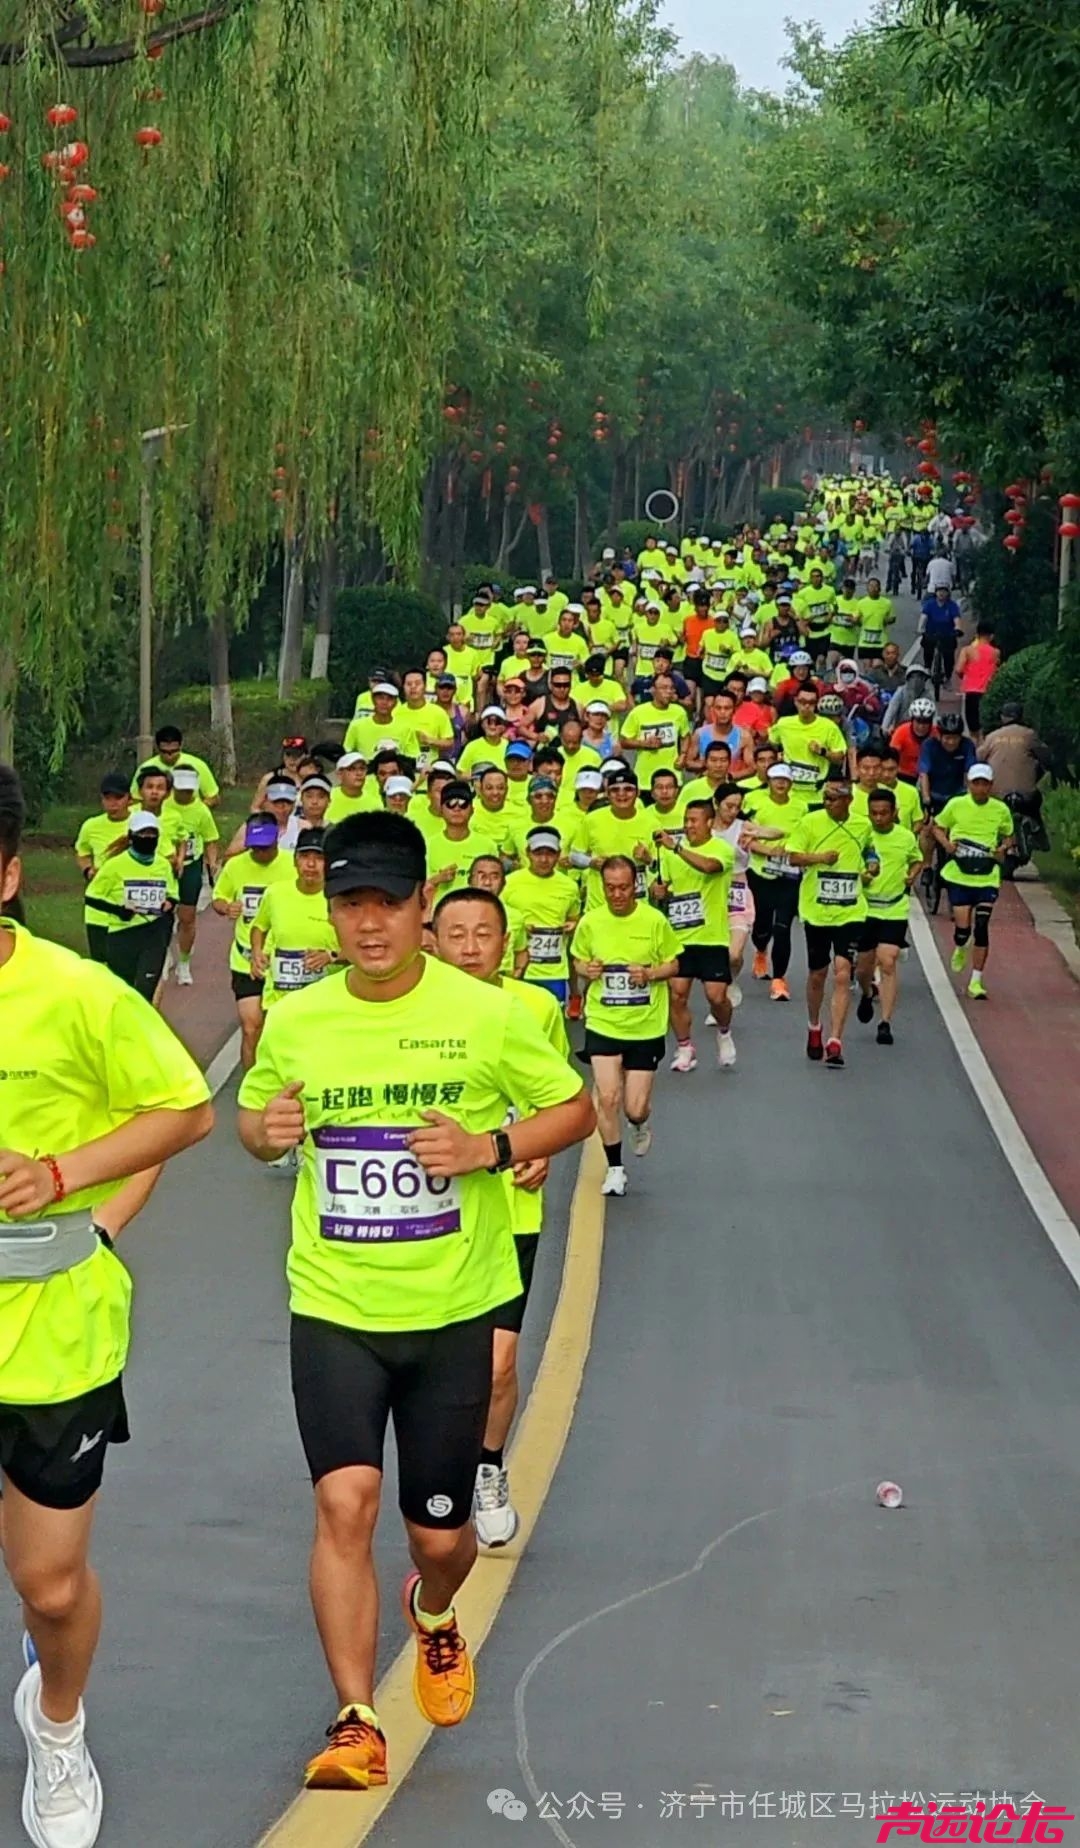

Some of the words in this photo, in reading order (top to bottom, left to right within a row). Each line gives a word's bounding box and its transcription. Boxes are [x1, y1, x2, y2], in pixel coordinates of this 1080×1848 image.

[527, 936, 560, 950] 244
[280, 961, 323, 975] C5
[399, 1038, 467, 1050] Casarte
[383, 1080, 466, 1106] 慢慢爱
